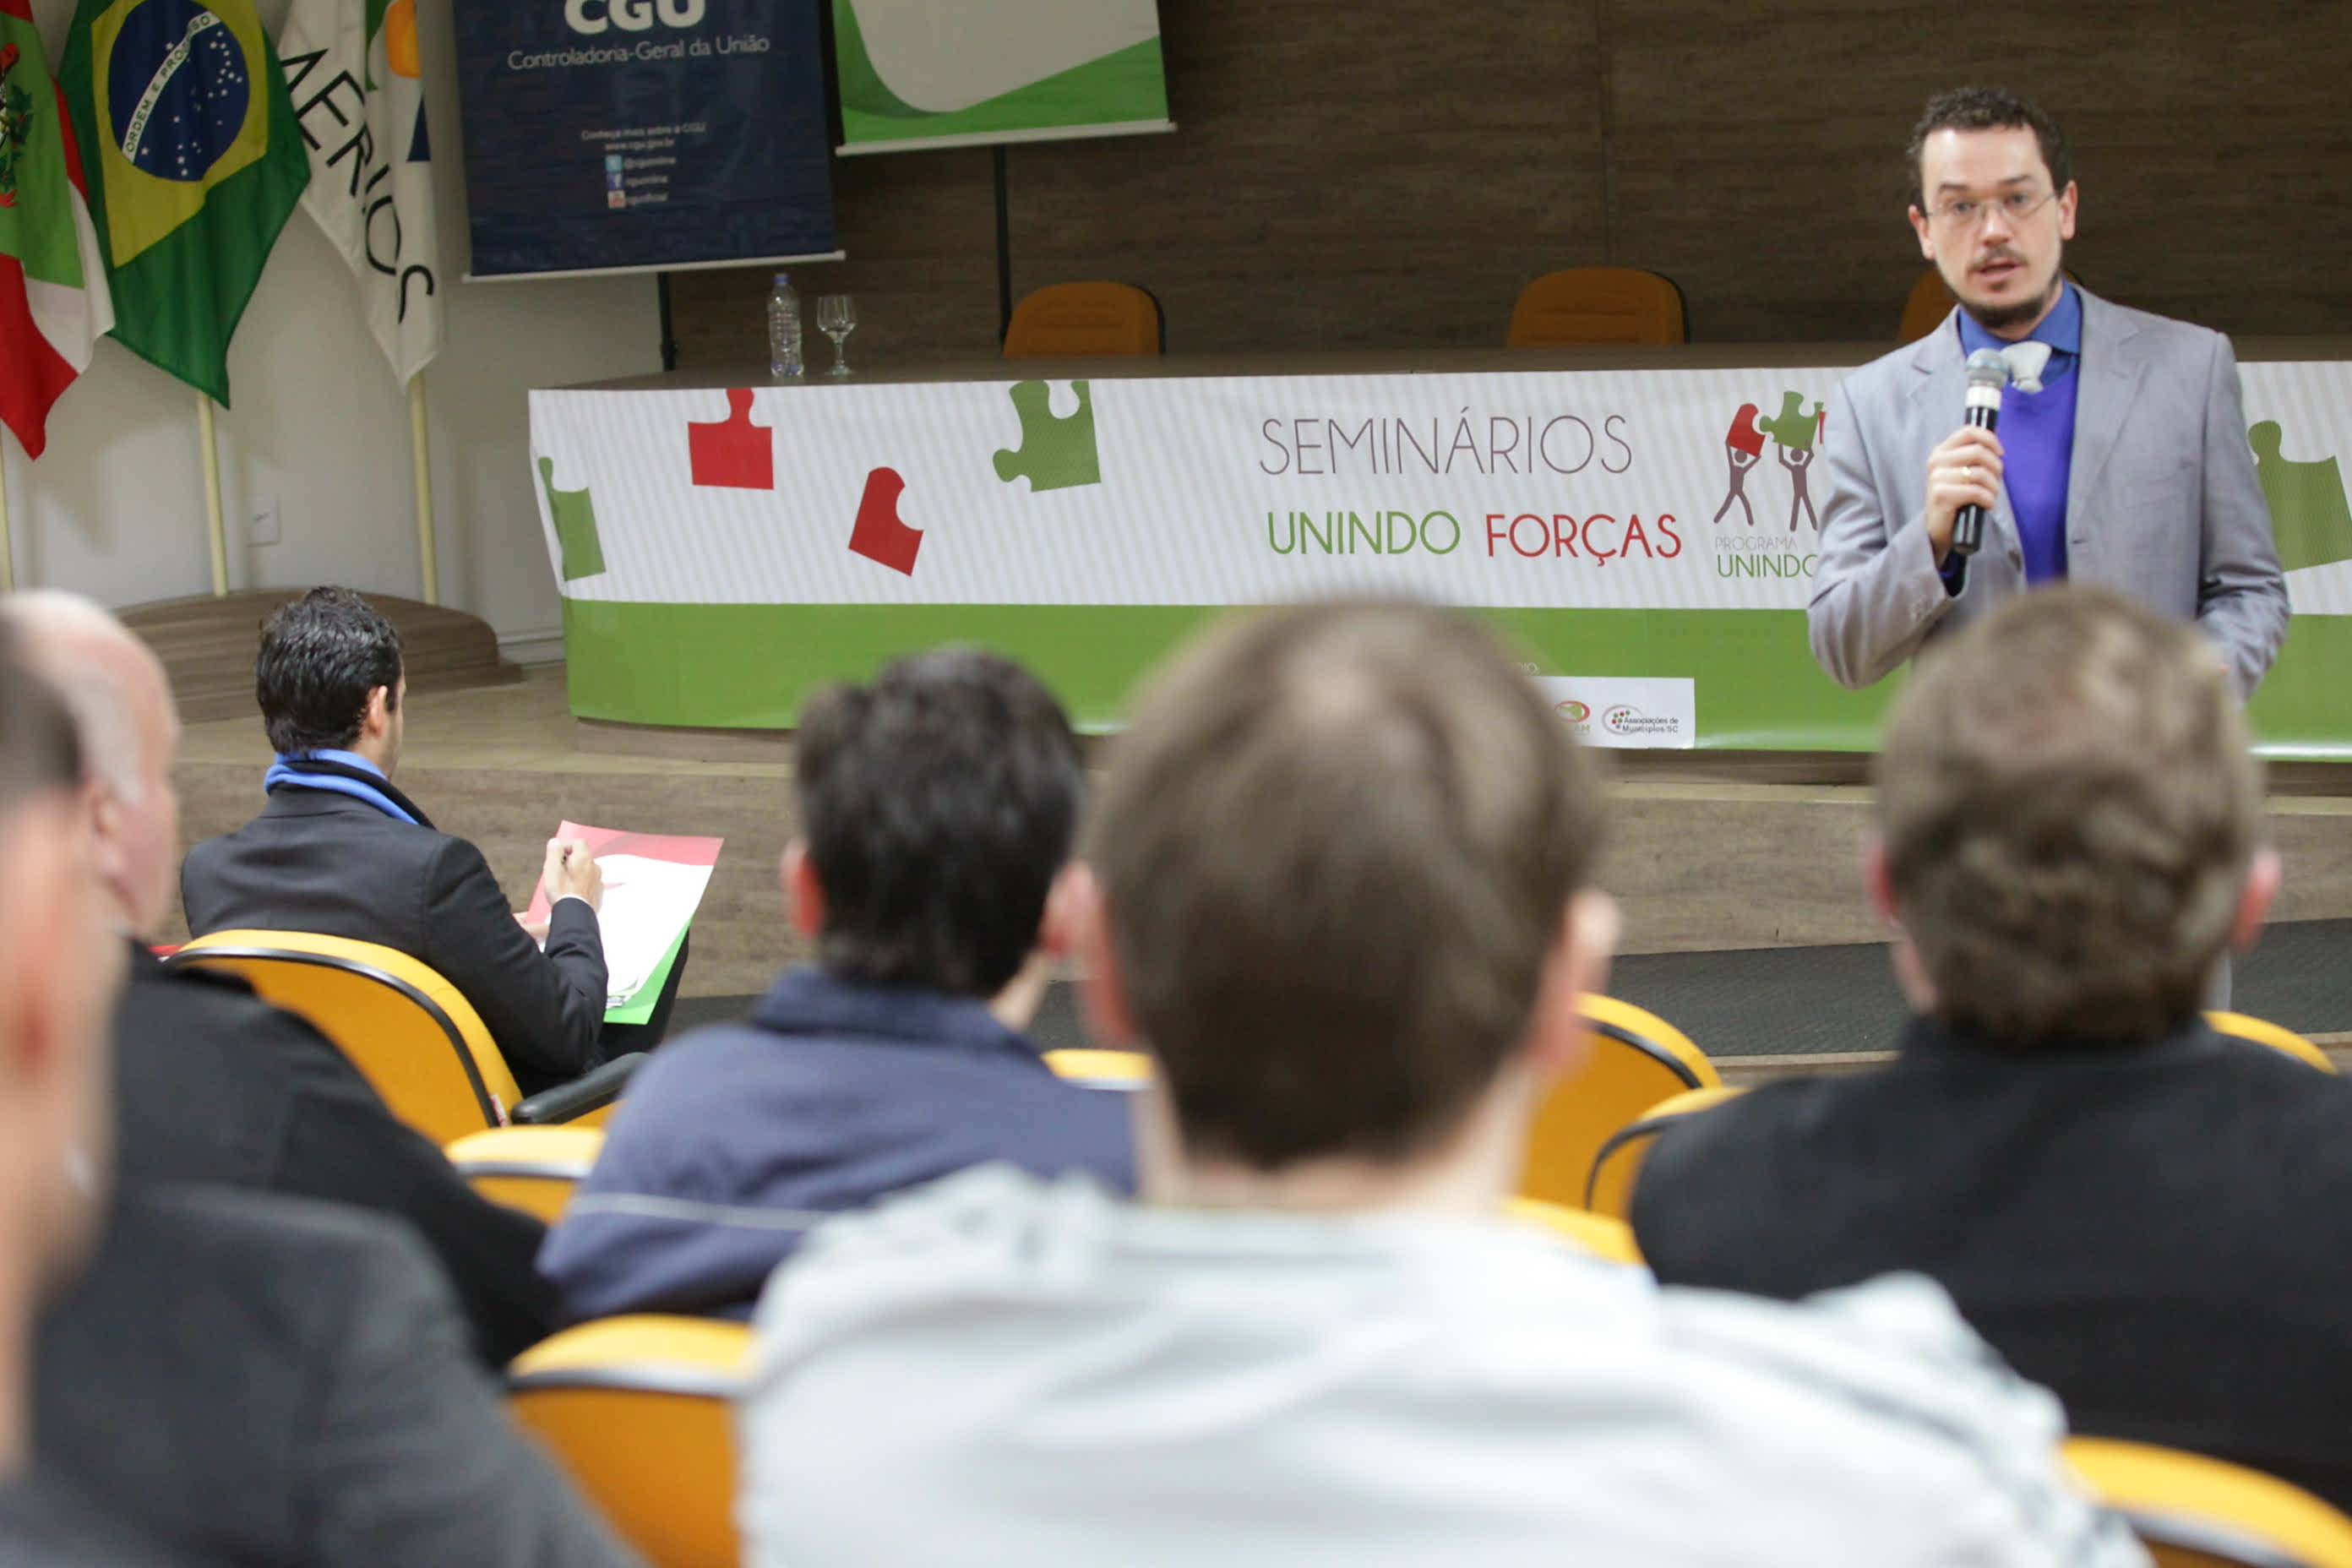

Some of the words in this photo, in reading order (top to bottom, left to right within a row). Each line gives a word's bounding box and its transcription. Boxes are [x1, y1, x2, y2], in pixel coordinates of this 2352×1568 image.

[564, 0, 705, 35] CGU
[508, 41, 685, 69] Controladoria-Geral
[689, 40, 711, 57] da
[716, 35, 770, 55] União
[126, 99, 151, 152] ORDEM
[1260, 406, 1632, 475] SEMINÁRIOS
[1267, 510, 1461, 555] UNINDO
[1485, 514, 1681, 567] FORÇAS
[1715, 536, 1798, 551] PROGRAMA
